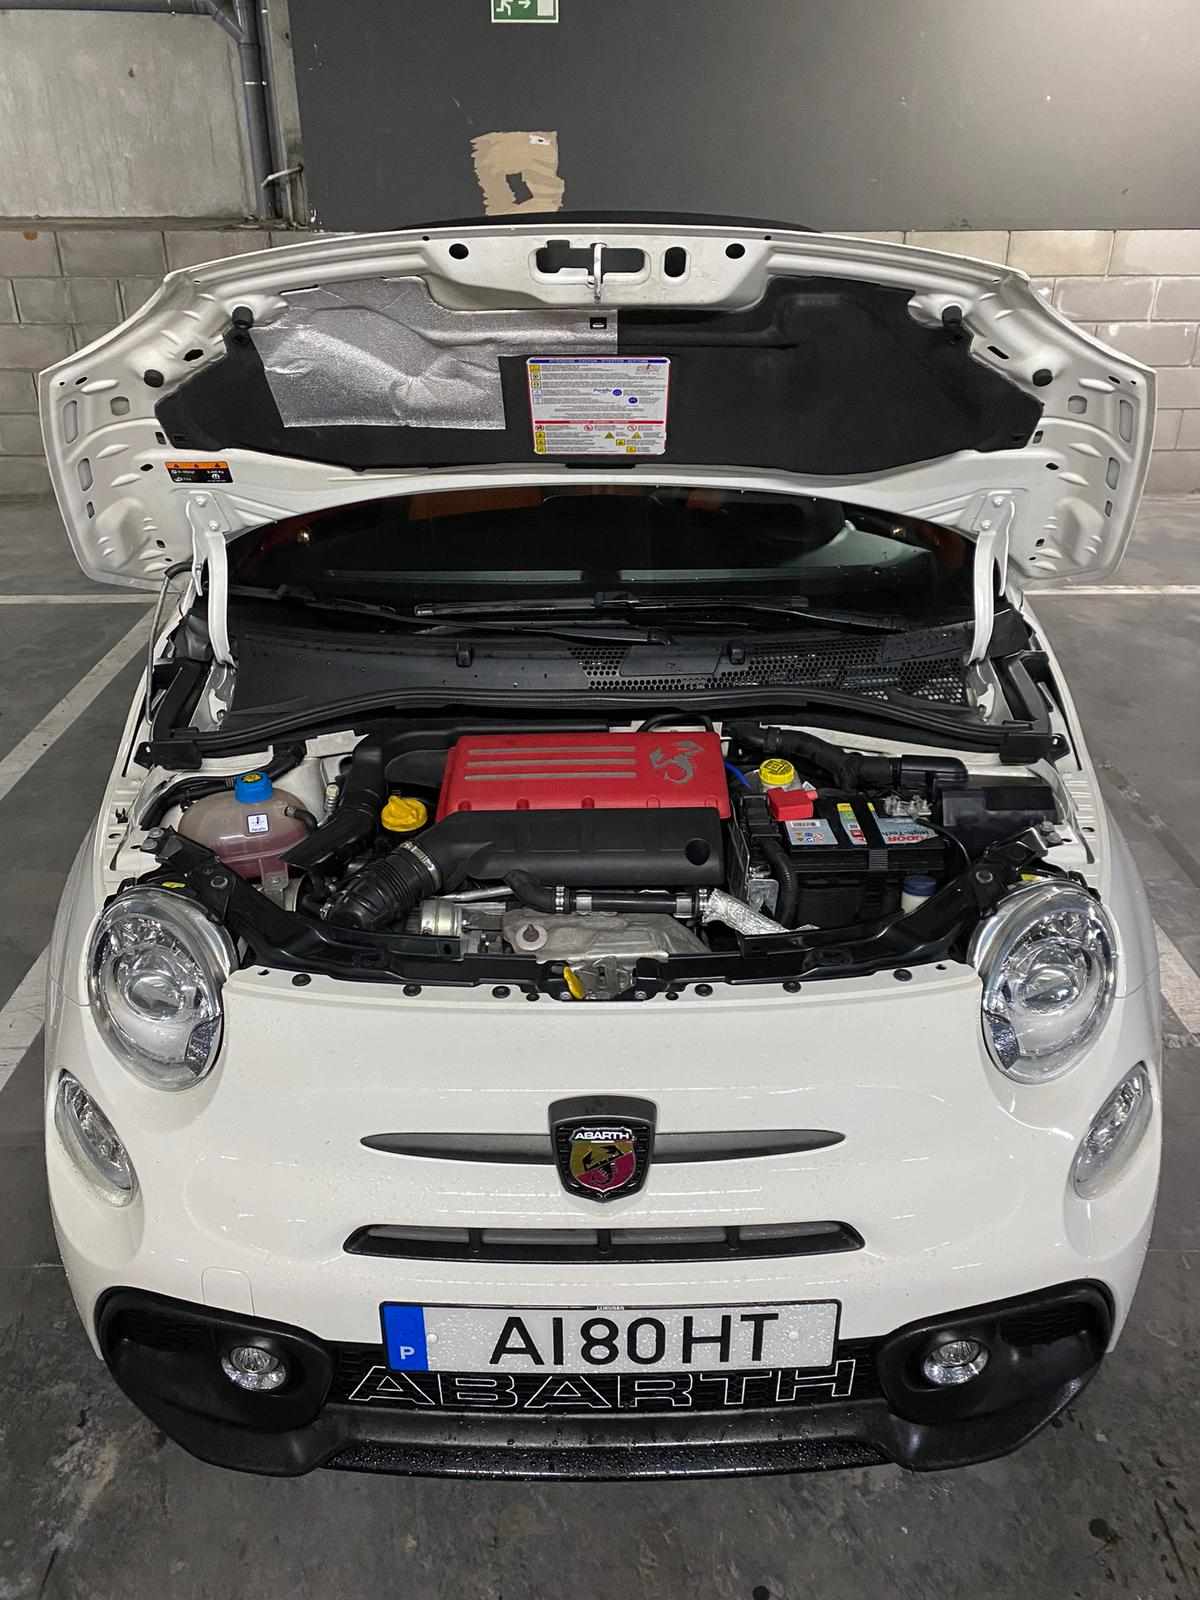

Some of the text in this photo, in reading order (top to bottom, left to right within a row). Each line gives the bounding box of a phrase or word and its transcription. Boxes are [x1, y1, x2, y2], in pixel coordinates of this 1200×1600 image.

[574, 1131, 629, 1140] ABARTH
[399, 1345, 415, 1361] P
[488, 1312, 779, 1366] AI80HT
[347, 1358, 856, 1409] ABARTH
